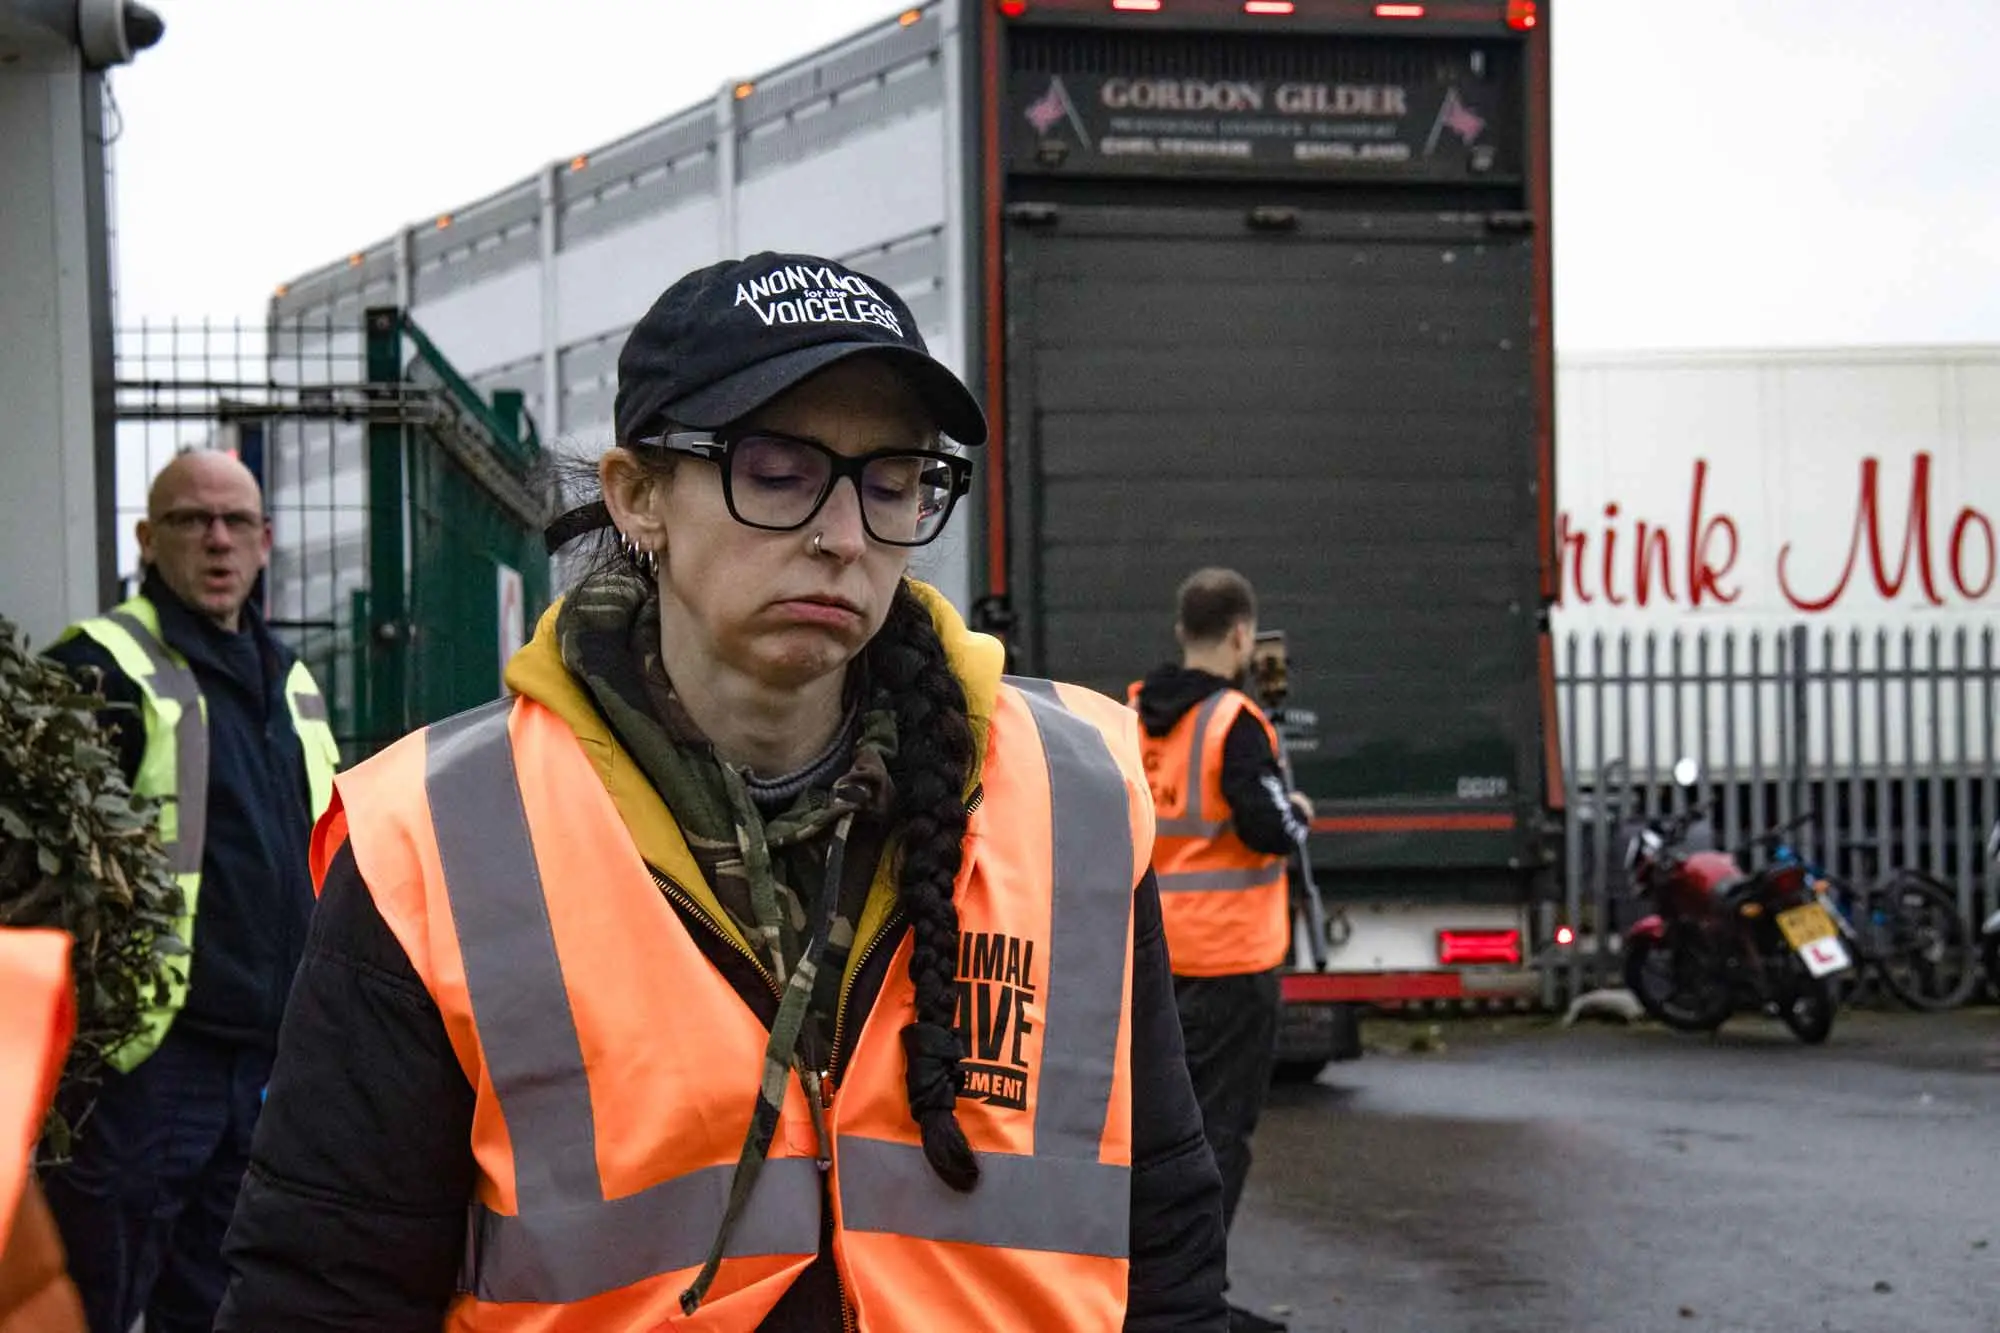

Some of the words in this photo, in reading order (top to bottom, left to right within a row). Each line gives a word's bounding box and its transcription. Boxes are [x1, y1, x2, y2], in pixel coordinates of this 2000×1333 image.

[1101, 78, 1263, 110] GORDON
[1275, 83, 1407, 116] GILDER
[734, 265, 892, 310] ANONYMOU
[803, 288, 824, 299] for
[826, 288, 848, 299] the
[749, 297, 904, 338] VOICELESS
[1555, 457, 1742, 608] rink
[1777, 451, 1997, 613] Mo
[954, 931, 1036, 990] IMAL
[1809, 945, 1835, 964] L
[952, 981, 1035, 1068] AVE
[964, 1070, 1023, 1101] MENT
